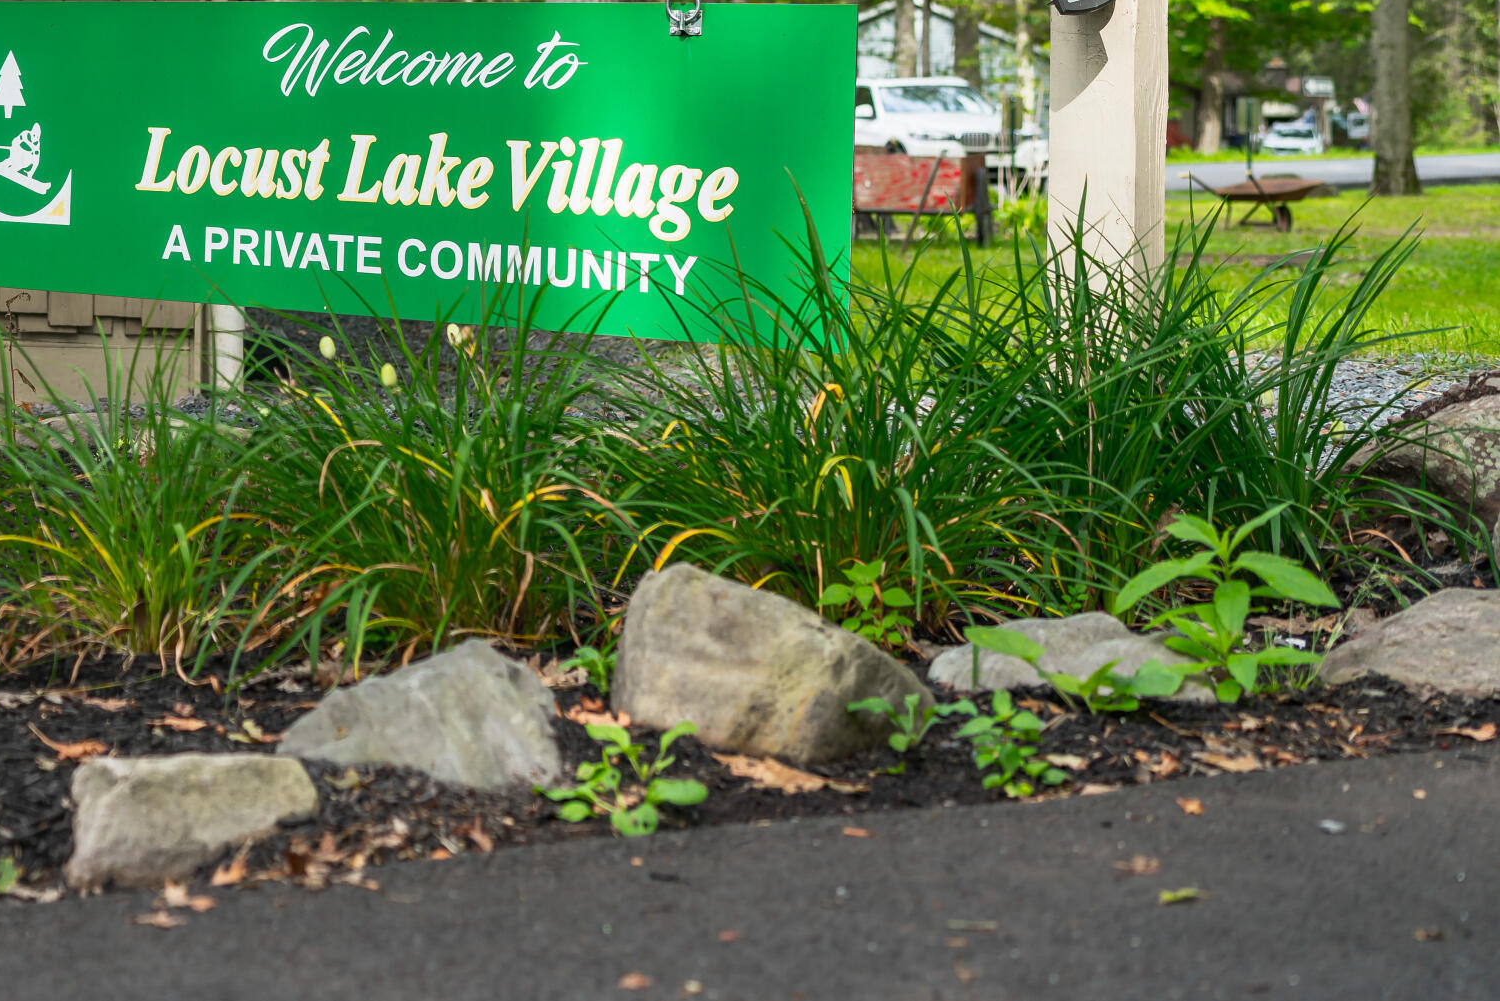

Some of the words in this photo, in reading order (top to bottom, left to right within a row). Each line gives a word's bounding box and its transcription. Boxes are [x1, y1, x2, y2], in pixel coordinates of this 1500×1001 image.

[262, 23, 517, 97] Welcome
[523, 30, 589, 90] to
[134, 126, 331, 201] Locust
[336, 132, 494, 210] Lake
[506, 136, 740, 242] Village
[162, 224, 191, 262] A
[204, 226, 383, 275] PRIVATE
[397, 238, 699, 296] COMMUNITY
